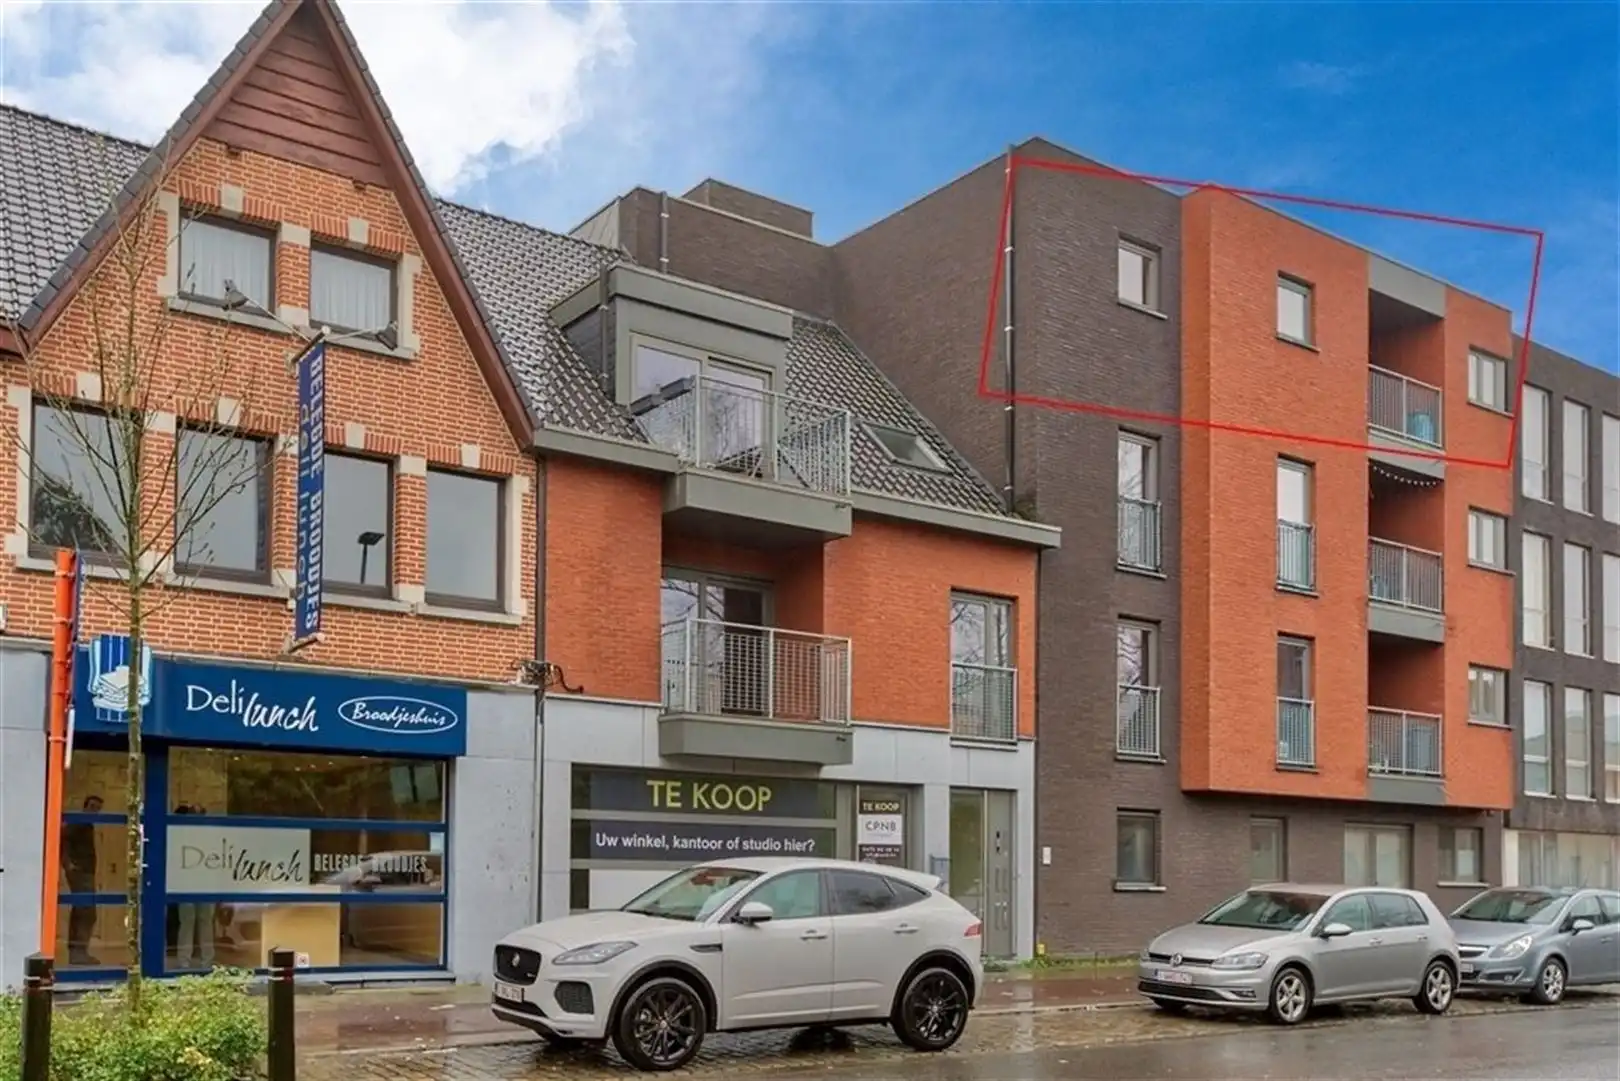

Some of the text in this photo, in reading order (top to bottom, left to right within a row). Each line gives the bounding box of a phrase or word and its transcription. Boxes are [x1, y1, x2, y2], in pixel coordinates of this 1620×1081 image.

[305, 354, 322, 629] BELEGDE BROODJES
[351, 702, 446, 727] Broodjeshuis
[646, 780, 772, 812] TE KOOP
[863, 802, 900, 811] TE KOOP
[595, 832, 815, 853] Uw winkel, kantoor of studio hier?
